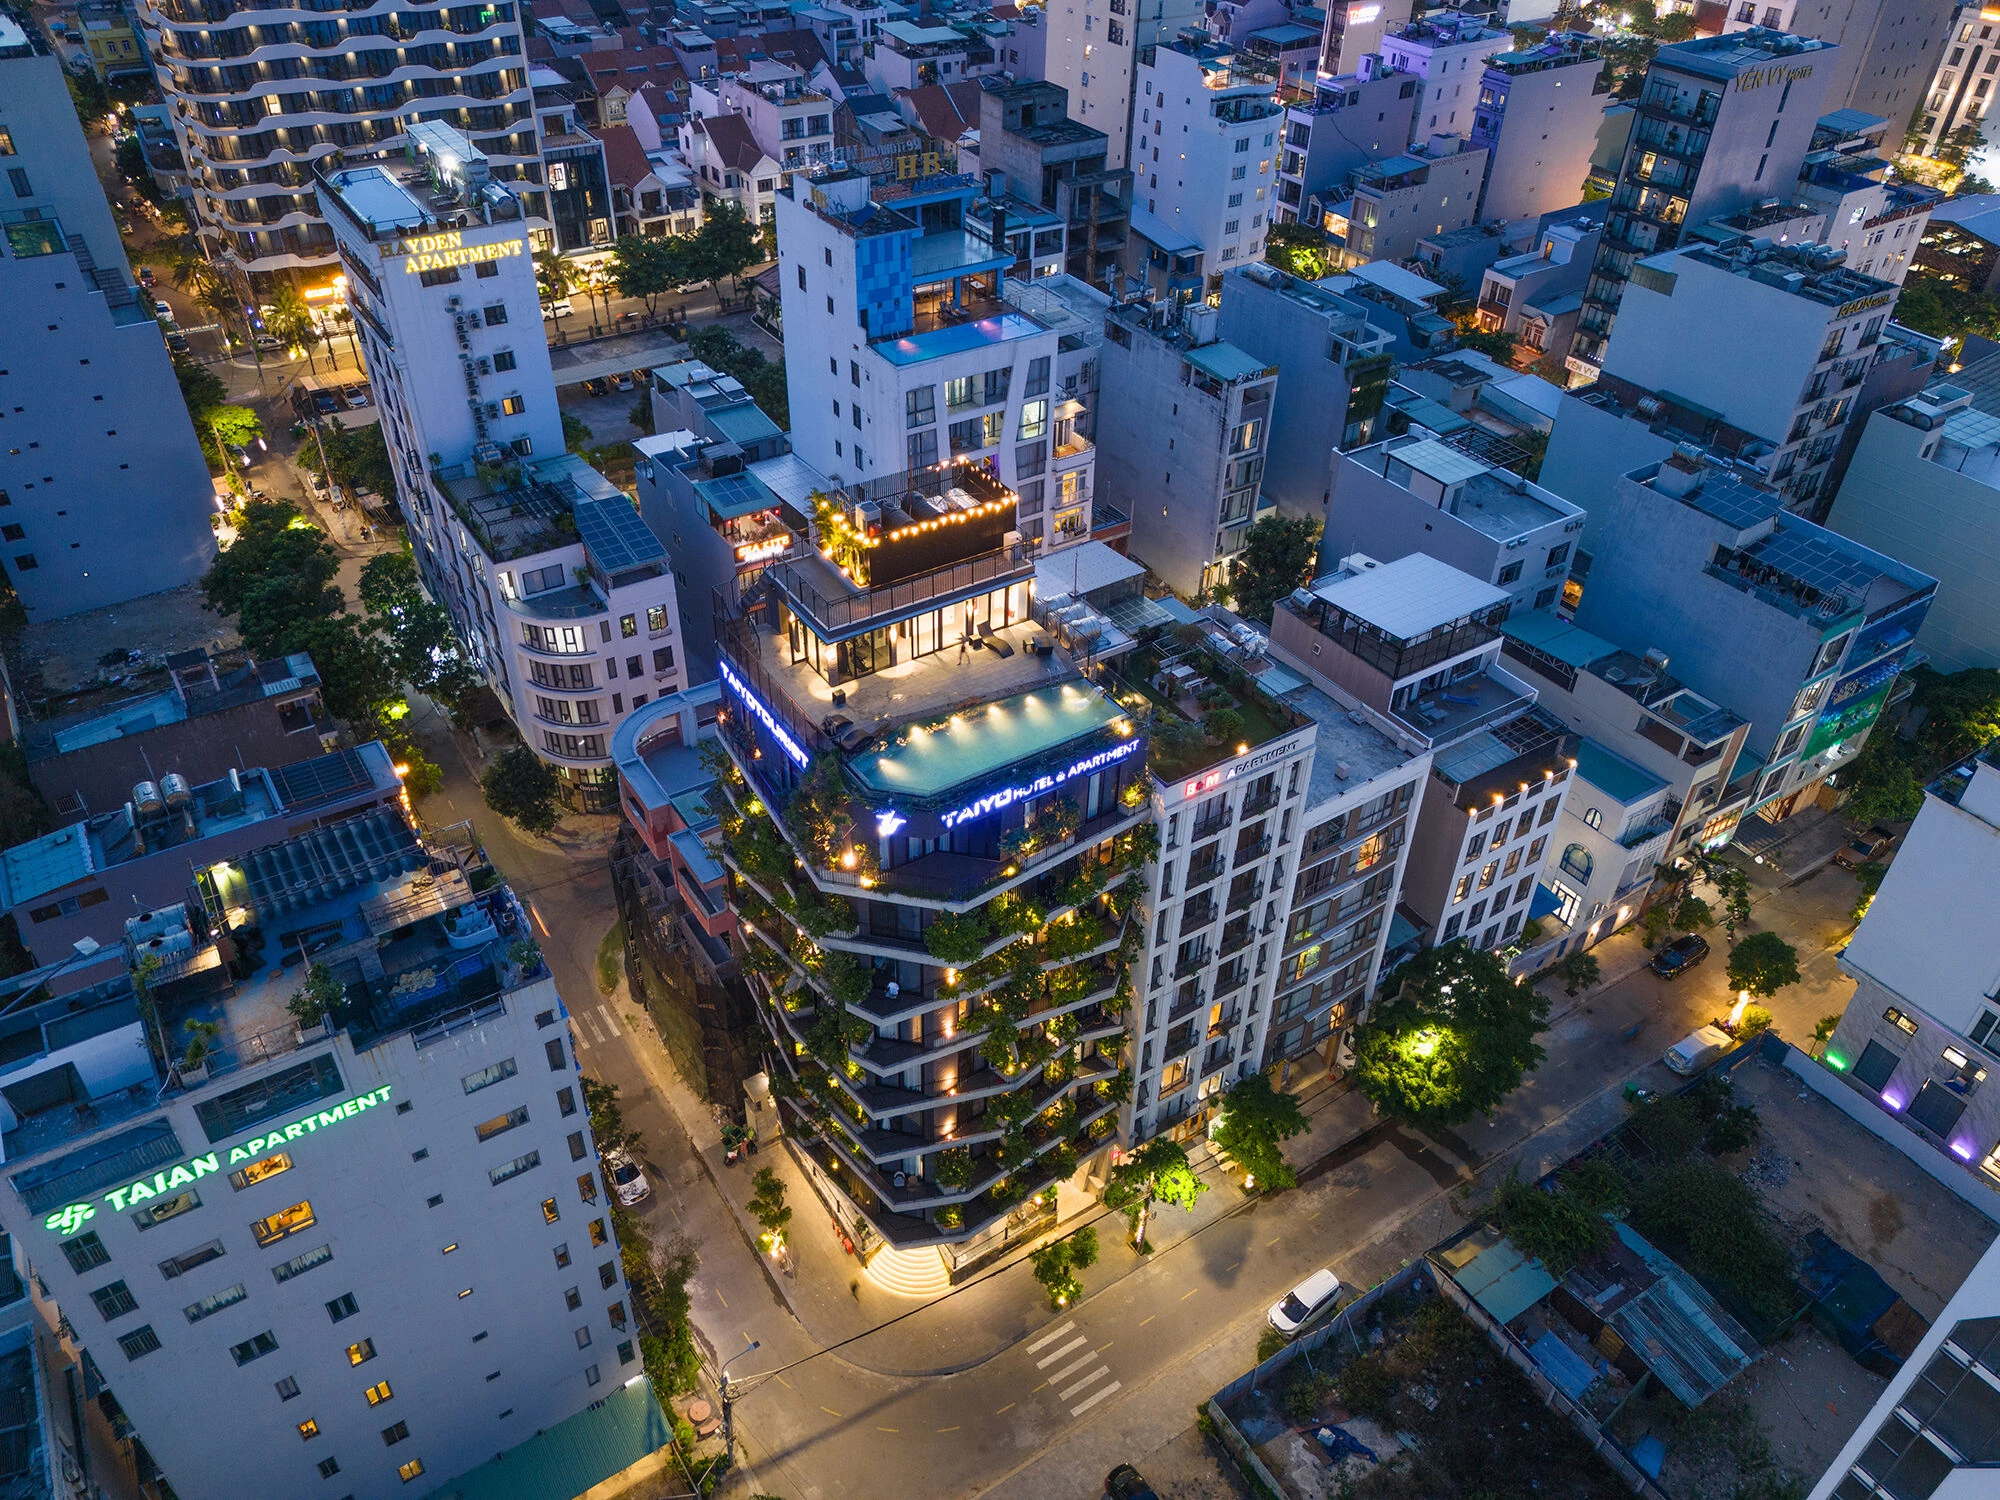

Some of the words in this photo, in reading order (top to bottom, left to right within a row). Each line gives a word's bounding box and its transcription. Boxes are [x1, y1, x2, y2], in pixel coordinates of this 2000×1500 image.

[1768, 64, 1791, 86] VY
[896, 151, 941, 180] HB
[380, 231, 462, 258] HAYDEN
[405, 239, 523, 274] APARTMENT
[738, 543, 760, 557] SEA
[1226, 739, 1300, 780] APARTMENT
[941, 788, 1012, 829] TAIYO
[1013, 775, 1054, 800] HOTEL
[1056, 771, 1067, 783] &
[1067, 739, 1140, 778] APARTMENT
[104, 1151, 220, 1213] TAIAN
[228, 1084, 393, 1166] APARTMENT
